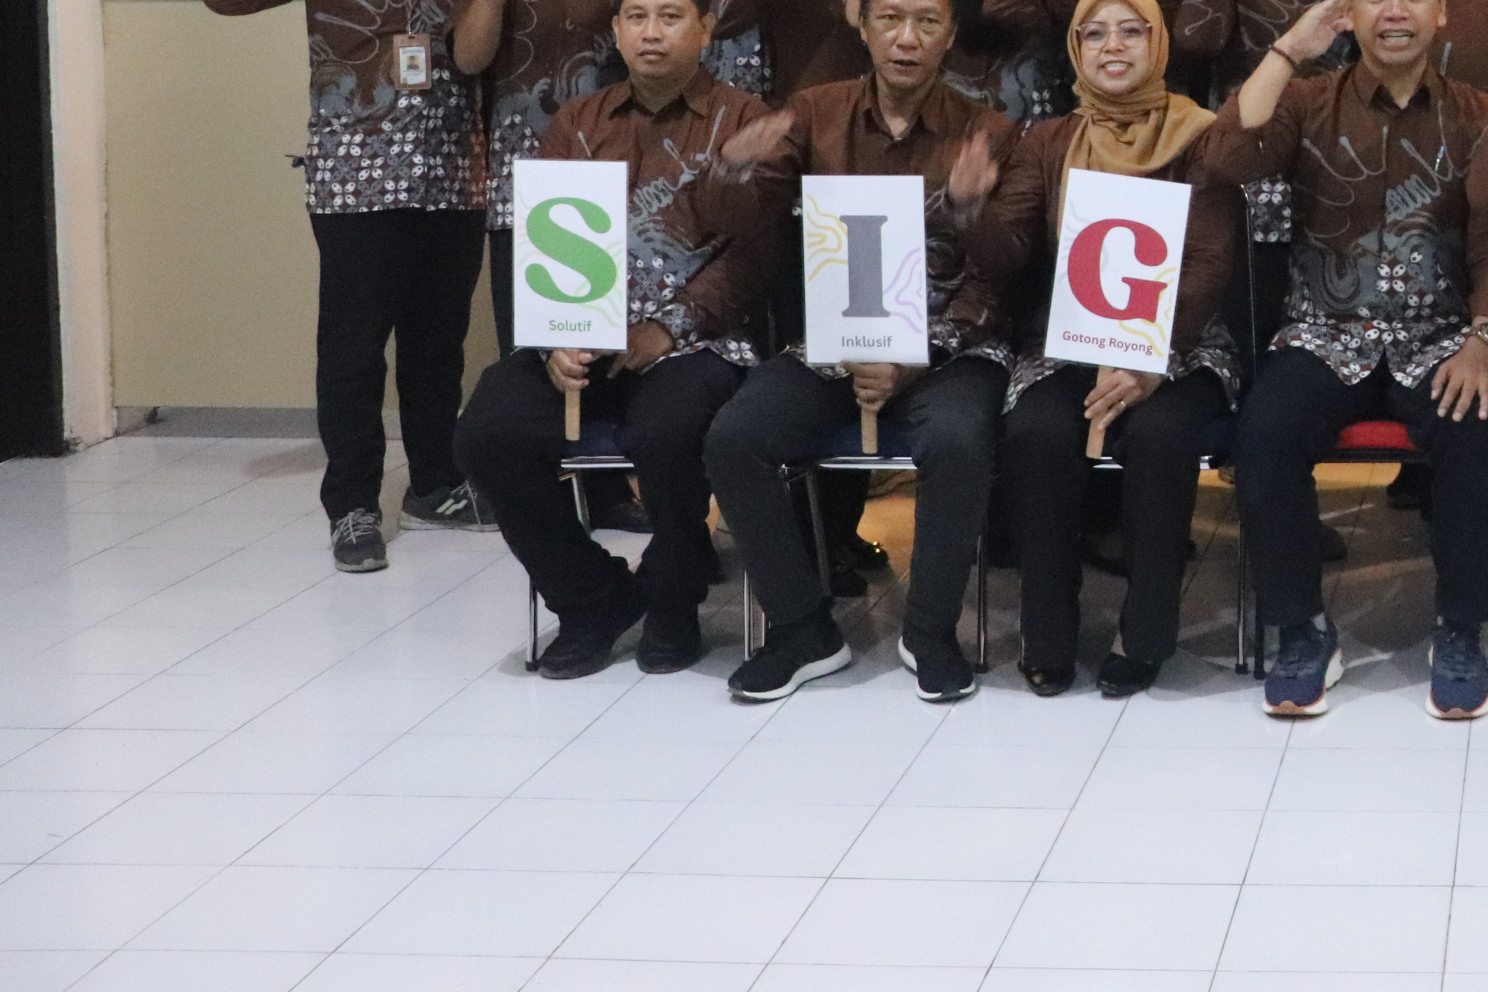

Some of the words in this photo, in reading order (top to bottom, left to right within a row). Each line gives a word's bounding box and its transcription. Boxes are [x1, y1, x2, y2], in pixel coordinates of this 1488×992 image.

[525, 196, 617, 304] S
[839, 214, 891, 318] I
[1067, 218, 1169, 323] G
[548, 319, 592, 333] Solutif
[840, 335, 893, 349] Inklusif
[1062, 330, 1106, 349] Gotong
[1108, 337, 1154, 355] Royong
